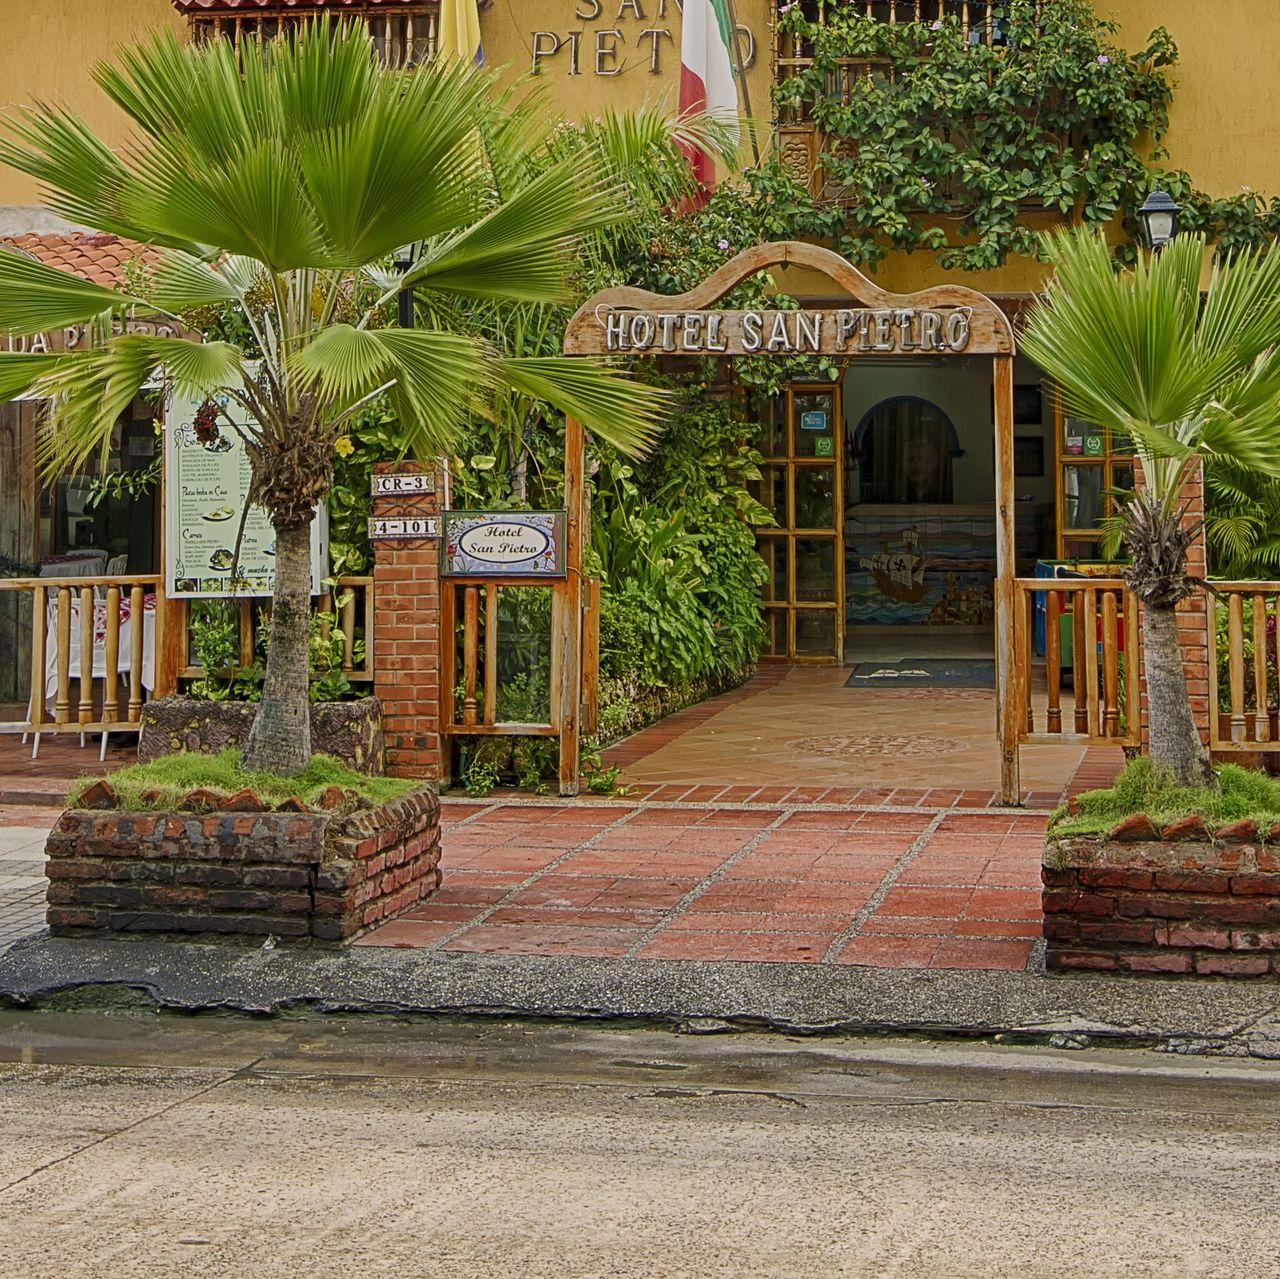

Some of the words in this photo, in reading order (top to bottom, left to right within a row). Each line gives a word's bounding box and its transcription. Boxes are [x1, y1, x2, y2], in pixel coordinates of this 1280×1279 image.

[531, 24, 756, 75] PIETO
[606, 312, 728, 351] HOTEL
[741, 311, 823, 351] SAN
[835, 308, 972, 351] PIETRO
[382, 477, 423, 491] CR-3
[379, 521, 430, 534] 4-101
[484, 526, 523, 537] Hotel
[468, 542, 494, 554] San
[497, 542, 538, 554] Pietro
